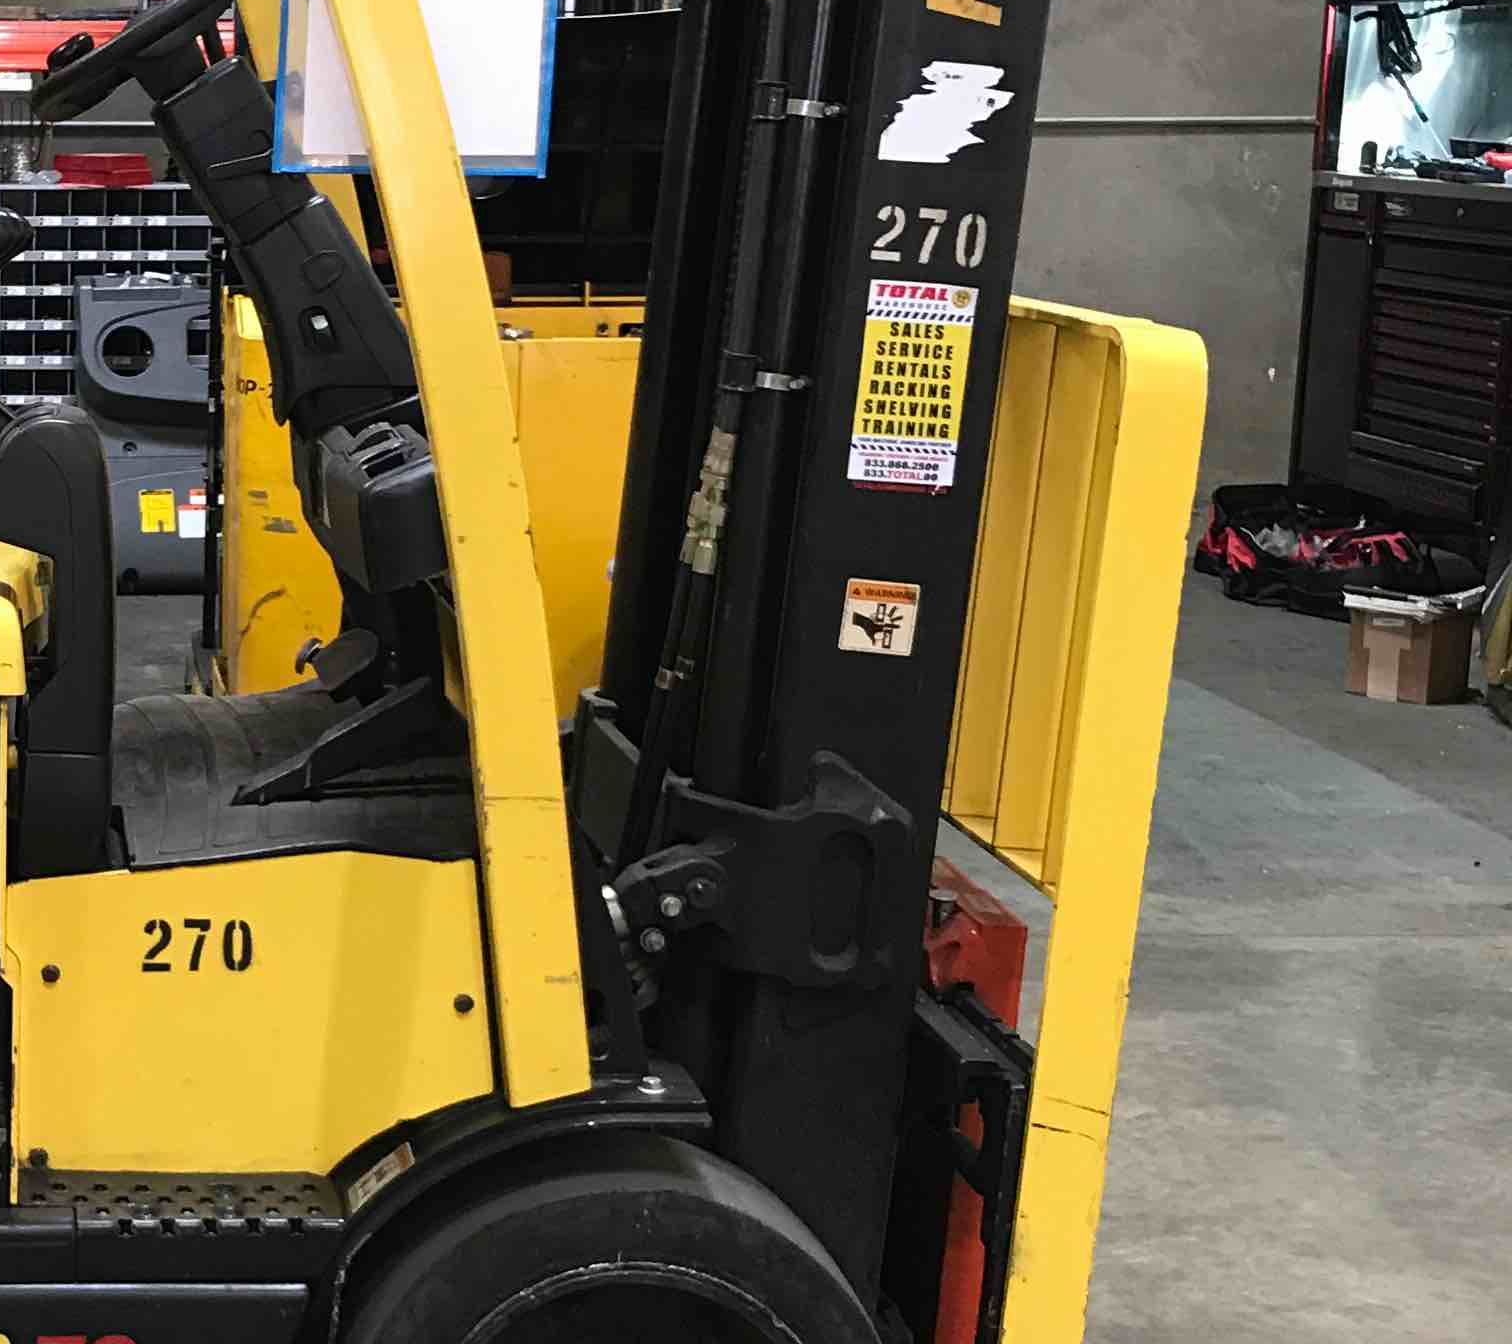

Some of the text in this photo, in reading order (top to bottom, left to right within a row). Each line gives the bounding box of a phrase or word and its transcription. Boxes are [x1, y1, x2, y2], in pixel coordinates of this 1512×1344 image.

[870, 205, 987, 268] 270
[875, 284, 949, 302] TOTAL
[890, 321, 945, 340] SALES
[876, 340, 953, 360] SERVICE
[873, 359, 952, 380] RENTALS
[869, 379, 952, 400] RACKING
[863, 398, 952, 419] SHELVING
[862, 418, 950, 439] TRAINING
[141, 917, 254, 973] 270
